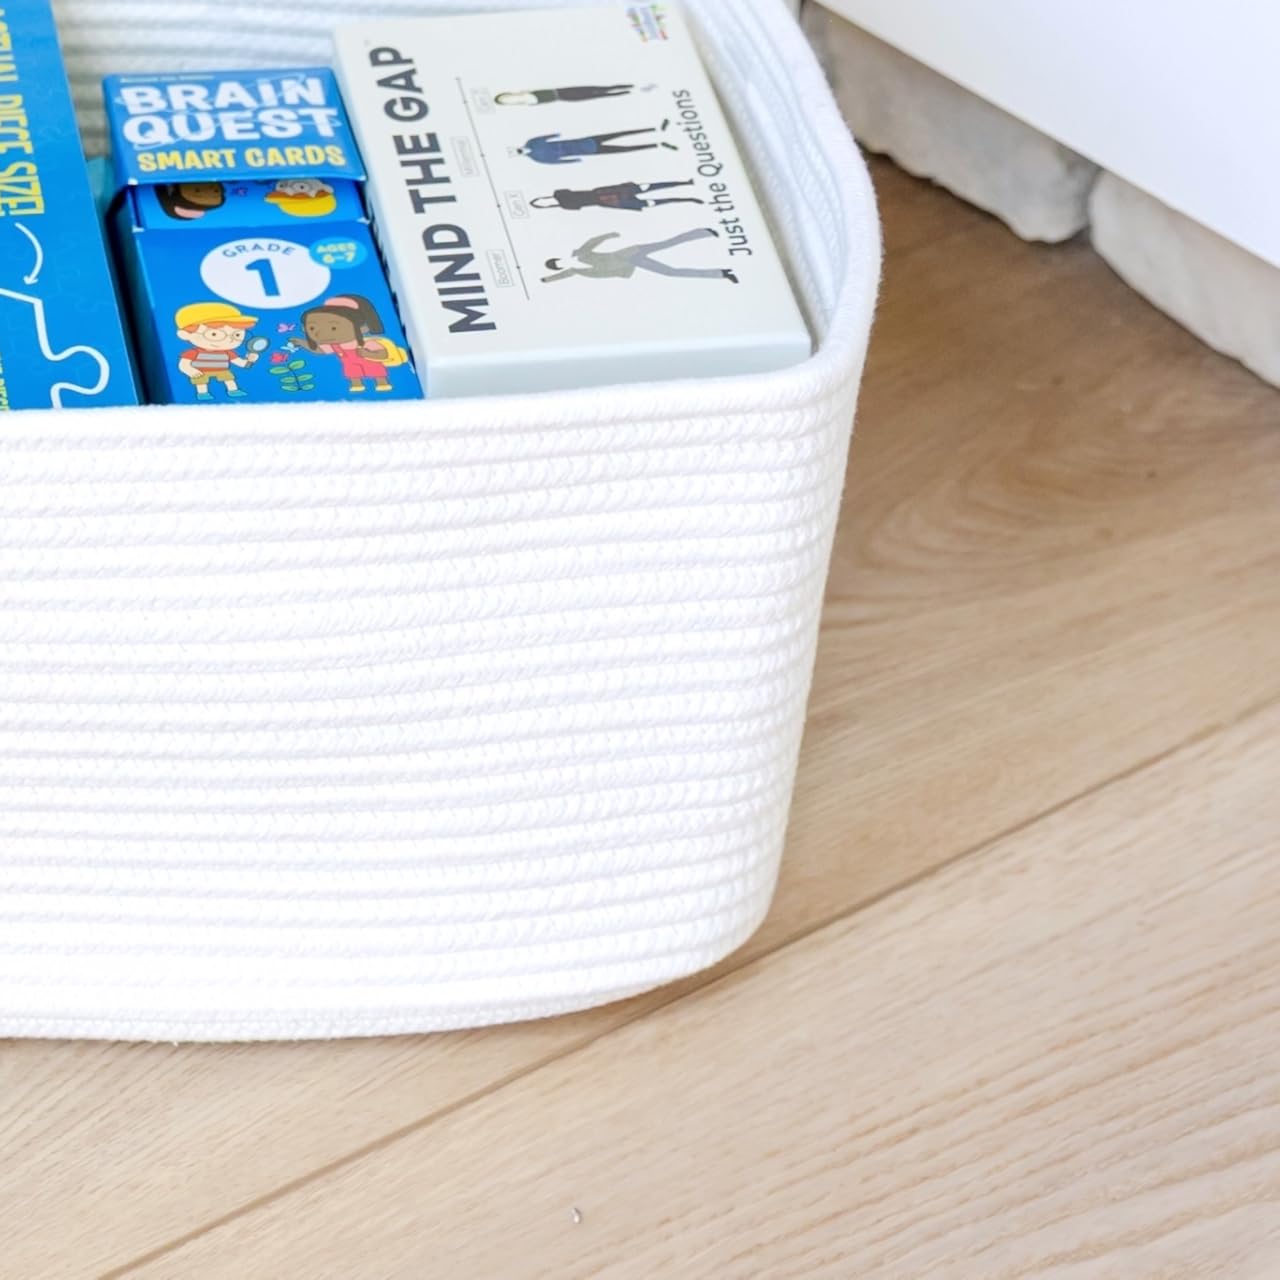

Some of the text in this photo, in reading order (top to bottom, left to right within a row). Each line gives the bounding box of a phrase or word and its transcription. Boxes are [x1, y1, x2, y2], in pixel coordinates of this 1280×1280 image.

[119, 76, 327, 116] BRAIN
[122, 106, 339, 146] QUEST
[136, 144, 348, 172] SMART CARDS
[671, 88, 753, 257] Just the Questions
[368, 45, 498, 334] MIND THE GAP
[221, 241, 297, 259] GRADE
[244, 258, 282, 298] 1
